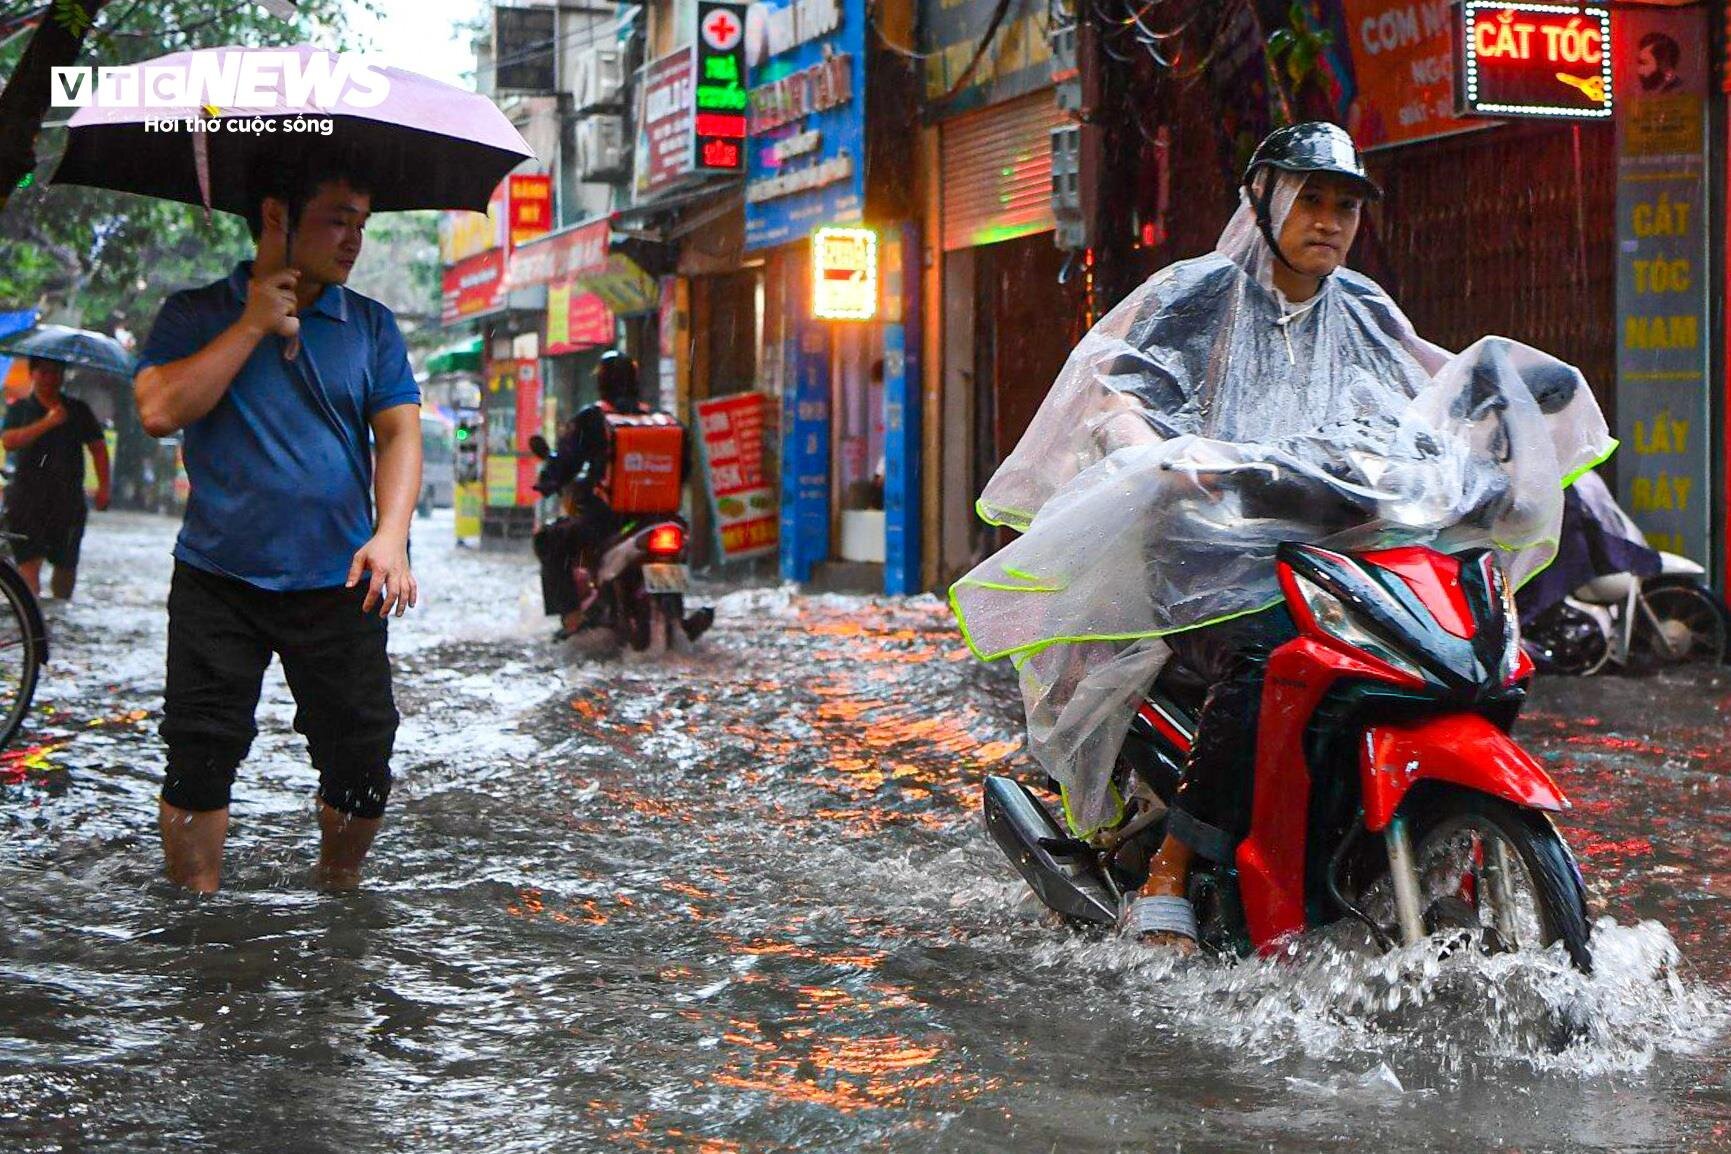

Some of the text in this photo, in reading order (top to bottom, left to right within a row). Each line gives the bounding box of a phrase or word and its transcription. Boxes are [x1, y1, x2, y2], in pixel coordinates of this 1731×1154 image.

[1475, 8, 1602, 63] CẮT TÓC
[1632, 254, 1692, 294] TÓC
[1624, 314, 1698, 349] NAM
